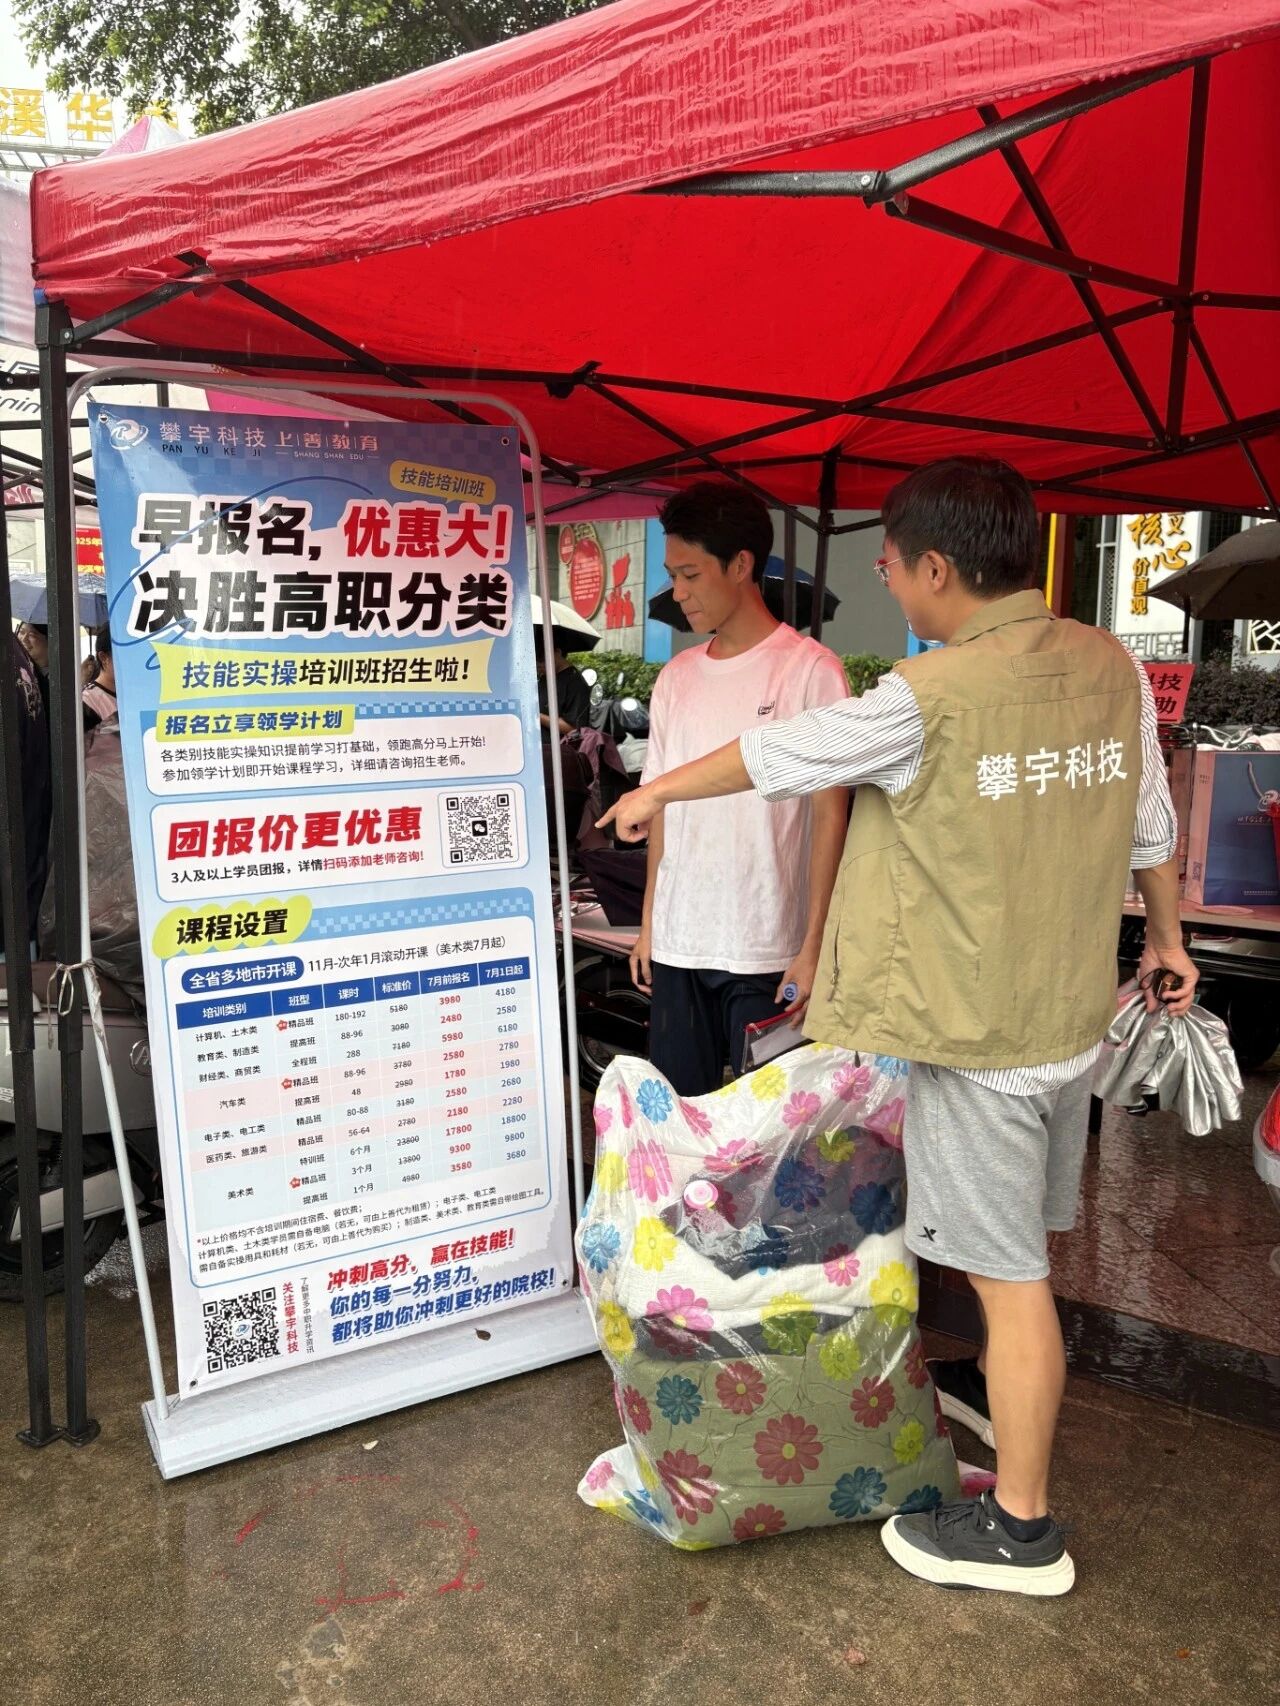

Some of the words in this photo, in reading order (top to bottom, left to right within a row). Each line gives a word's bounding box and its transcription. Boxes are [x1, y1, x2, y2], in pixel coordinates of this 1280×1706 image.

[160, 421, 266, 448] 攀宇科技
[275, 431, 378, 451] 上善教育
[162, 444, 183, 453] PAN
[195, 446, 208, 455] YU
[224, 448, 236, 456] KE
[252, 449, 261, 457] JI
[294, 451, 320, 459] SHANG
[350, 453, 364, 461] EDU
[400, 466, 486, 498] 技能培训班
[134, 569, 508, 634] 决胜高职分类
[182, 659, 470, 689] 技能实操培训班招生啦！
[165, 709, 344, 736] 报名立享领学计划
[162, 756, 467, 782] 参加领学计划即开始课程学习，详细请咨询招生老师。
[976, 737, 1128, 801] 攀宇科技
[168, 806, 423, 860] 团报价更优惠
[176, 908, 288, 945] 课程设置
[189, 961, 297, 990] 全省多地市开课
[202, 1002, 247, 1019] 培训类别
[288, 994, 310, 1007] 班型
[338, 986, 360, 1000] 课时
[382, 980, 412, 994] 标准价
[427, 972, 471, 987] 7月前报名
[485, 965, 524, 978] 7月1日起
[335, 1009, 366, 1022] 180-192
[439, 995, 461, 1005] 3980
[495, 987, 516, 997] 4180
[341, 1030, 363, 1040] 88-96
[440, 1013, 462, 1024] 2480
[496, 1005, 517, 1015] 2580
[344, 1069, 366, 1078] 88-96
[443, 1050, 465, 1061] 2580
[499, 1041, 519, 1051] 2780
[346, 1050, 361, 1059] 288
[441, 1032, 463, 1043] 5980
[498, 1023, 518, 1033] 6180
[351, 1088, 361, 1096] 48
[444, 1068, 466, 1079] 1780
[500, 1059, 520, 1069] 1980
[346, 1106, 369, 1117] 80-88
[445, 1087, 467, 1098] 2580
[501, 1076, 521, 1087] 2680
[348, 1127, 370, 1137] 56-64
[447, 1106, 468, 1117] 2180
[502, 1095, 522, 1106] 2280
[350, 1145, 371, 1156] 6个月
[445, 1124, 472, 1137] 17800
[502, 1113, 526, 1125] 18800
[351, 1164, 372, 1175] 3个月
[449, 1143, 471, 1154] 9300
[505, 1132, 525, 1143] 9800
[353, 1183, 374, 1194] 1个月
[451, 1161, 472, 1172] 3580
[506, 1150, 526, 1160] 3680
[283, 1282, 299, 1354] 关注攀宇科技
